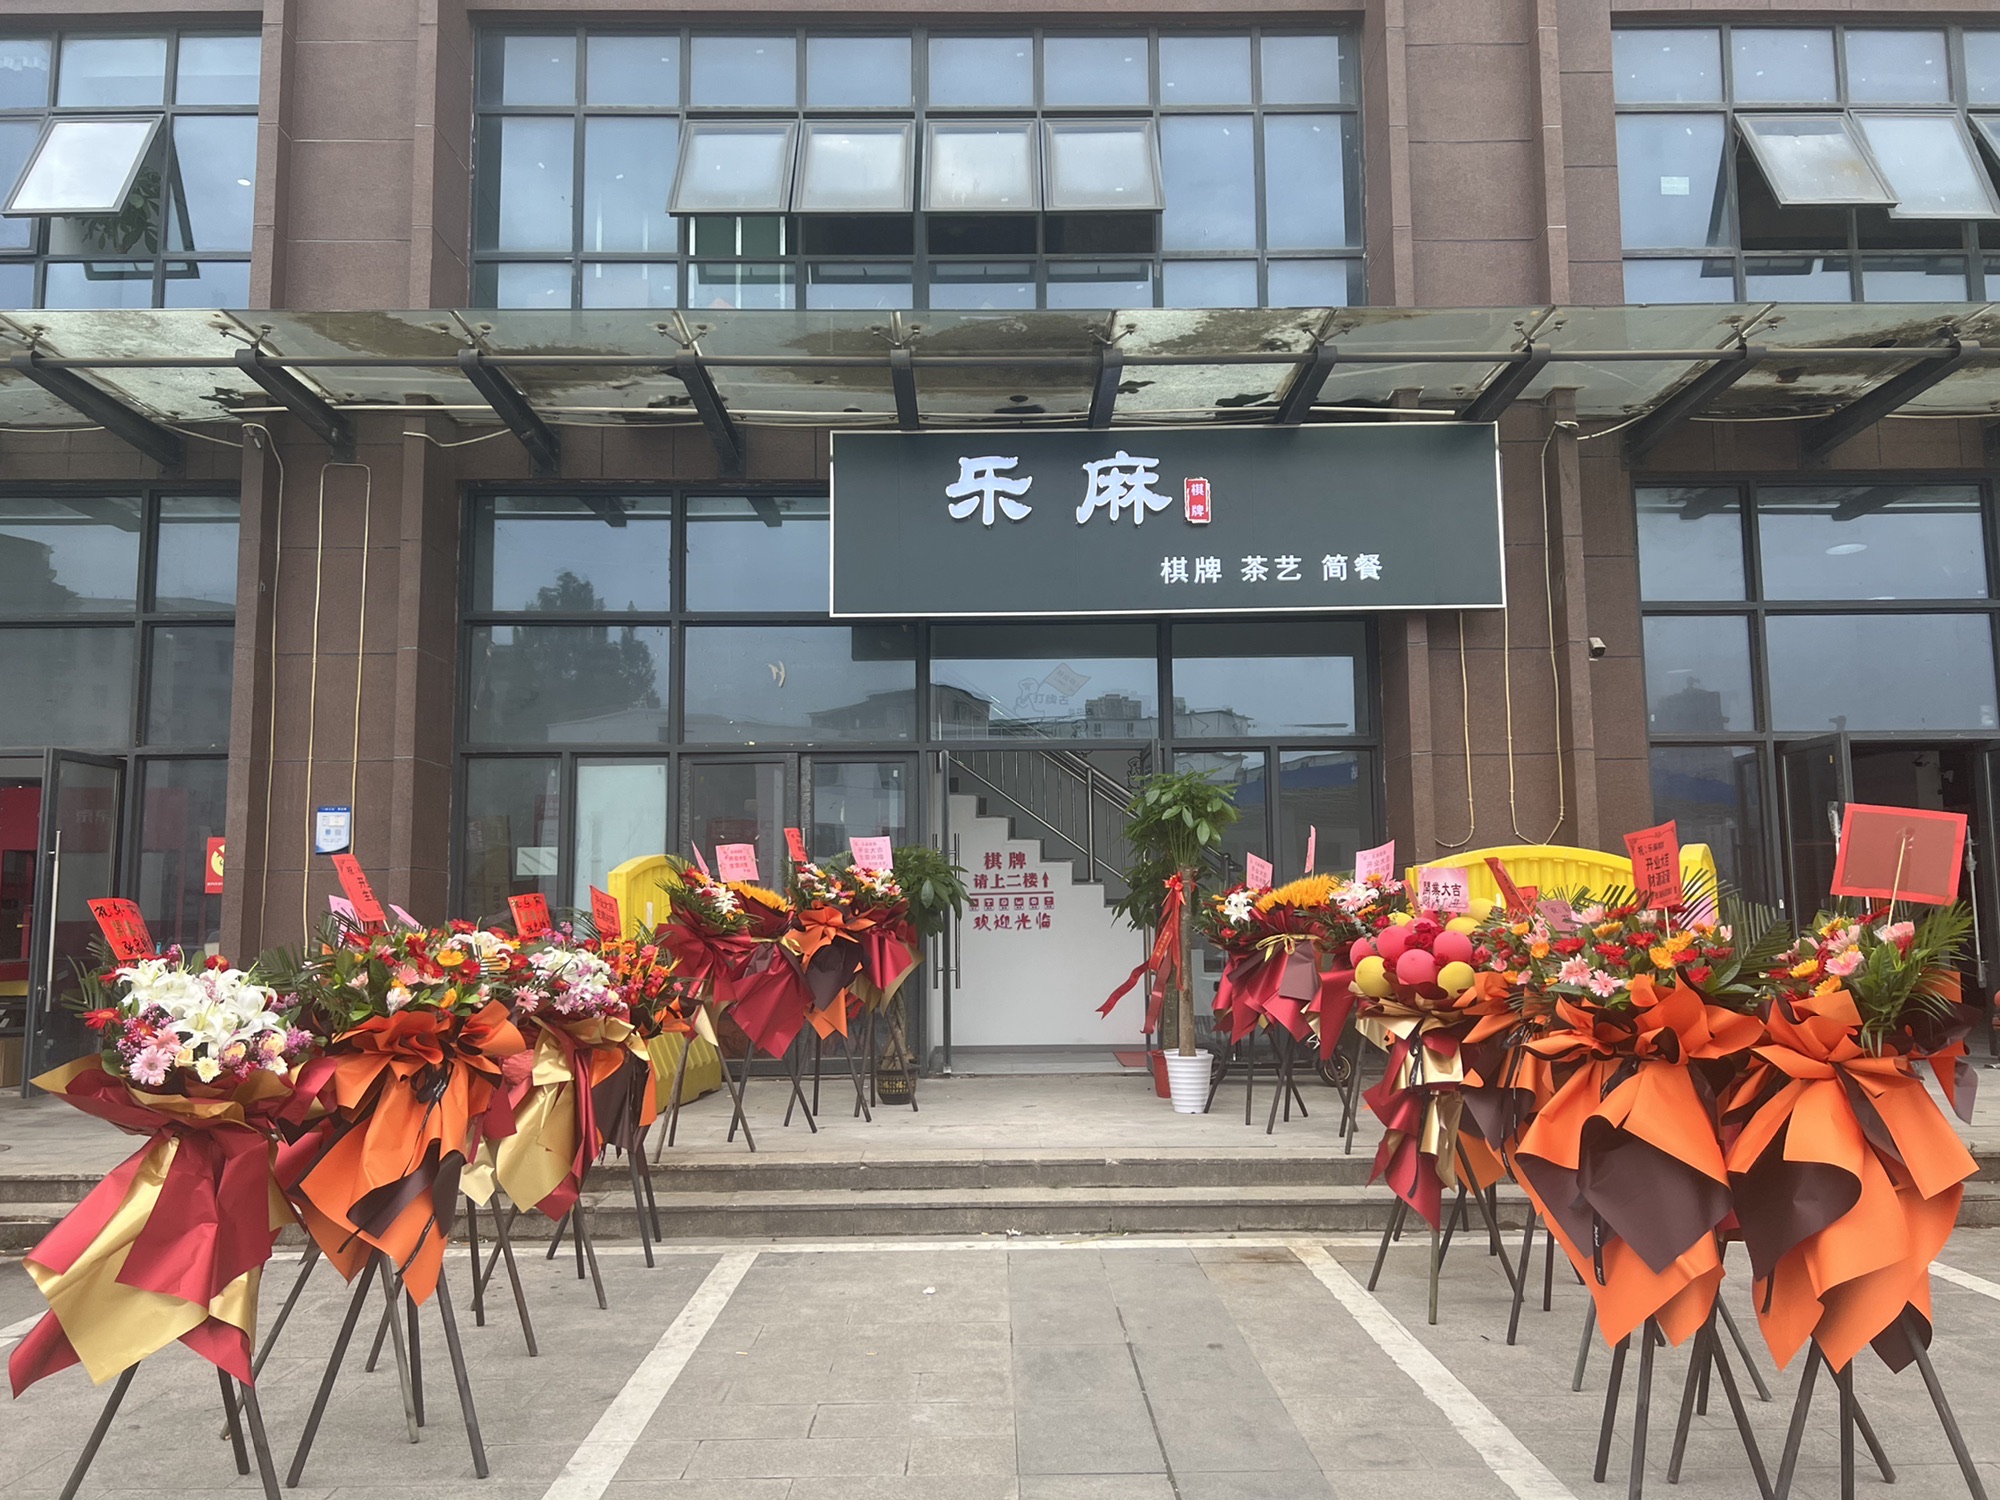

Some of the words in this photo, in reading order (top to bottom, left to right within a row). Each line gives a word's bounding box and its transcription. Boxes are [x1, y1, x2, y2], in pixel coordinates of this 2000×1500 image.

[945, 450, 1173, 526] 乐麻
[1190, 483, 1205, 518] 棋牌
[1160, 556, 1223, 584] 棋牌
[1241, 555, 1302, 583] 茶艺
[1321, 553, 1384, 582] 简餐
[984, 851, 1027, 870] 棋牌
[973, 872, 1039, 889] 请上二楼
[973, 912, 1051, 931] 欢迎光临
